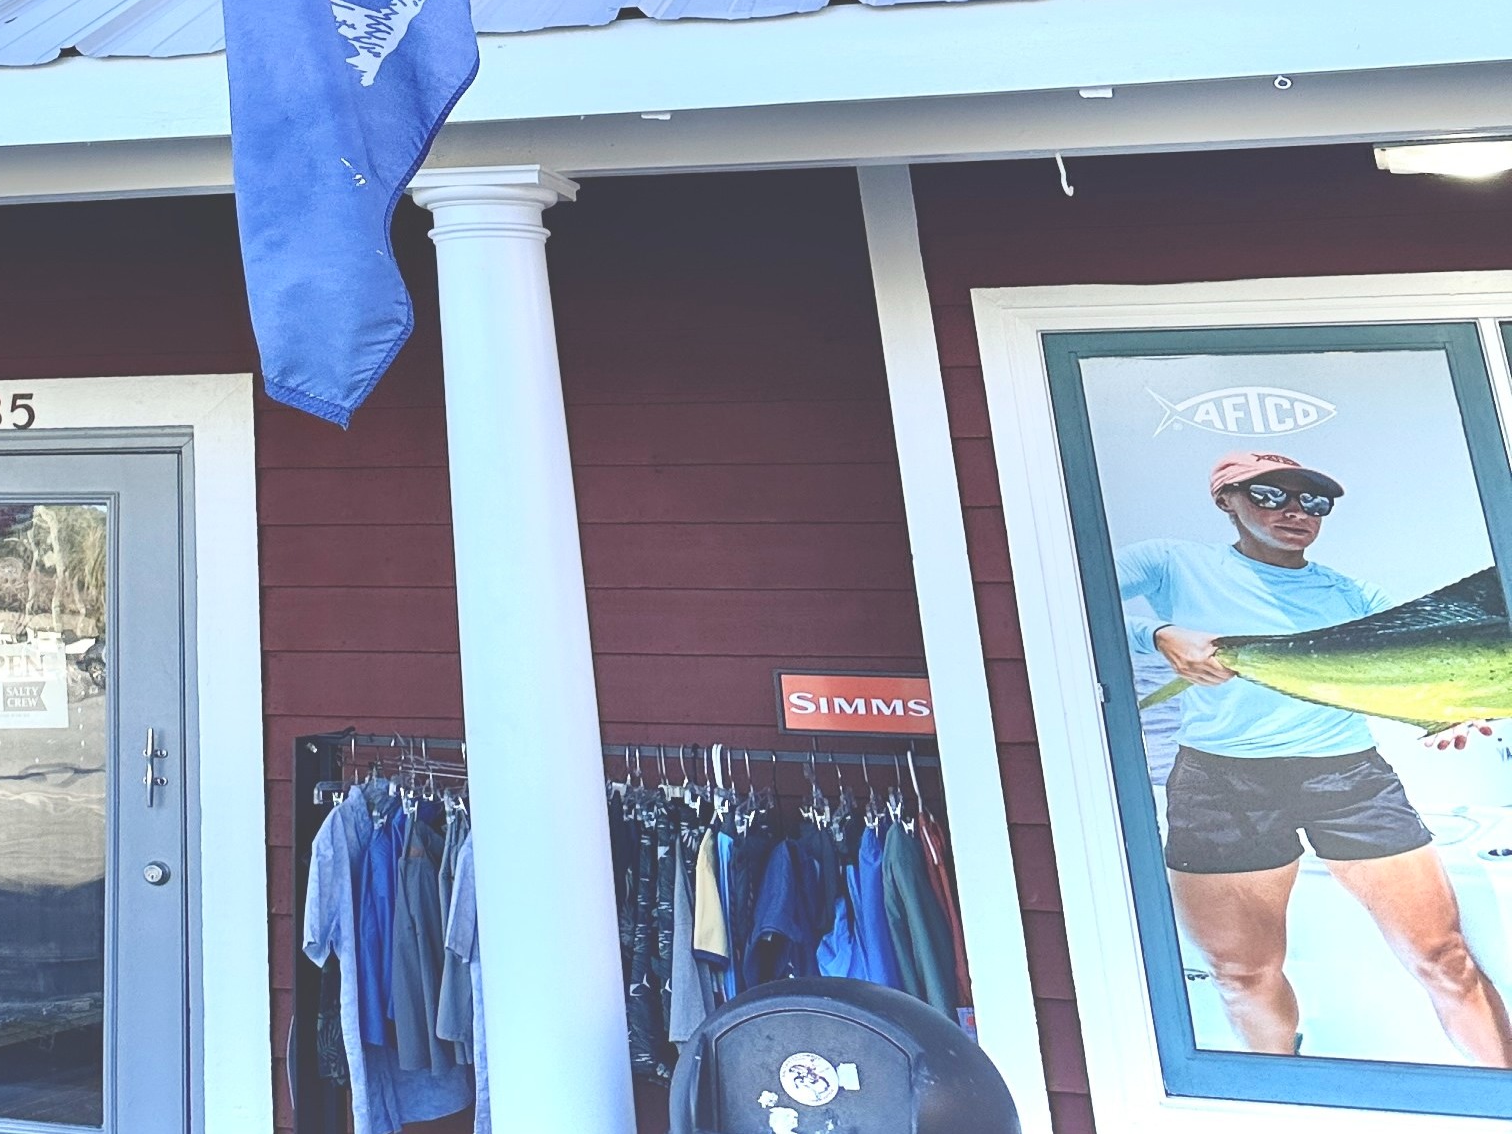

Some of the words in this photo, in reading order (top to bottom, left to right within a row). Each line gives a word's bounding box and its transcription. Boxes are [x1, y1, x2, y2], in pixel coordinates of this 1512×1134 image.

[1193, 391, 1319, 434] AFTCO
[5, 686, 39, 697] SALTY
[6, 697, 40, 708] CREW
[788, 692, 931, 717] SIMMS
